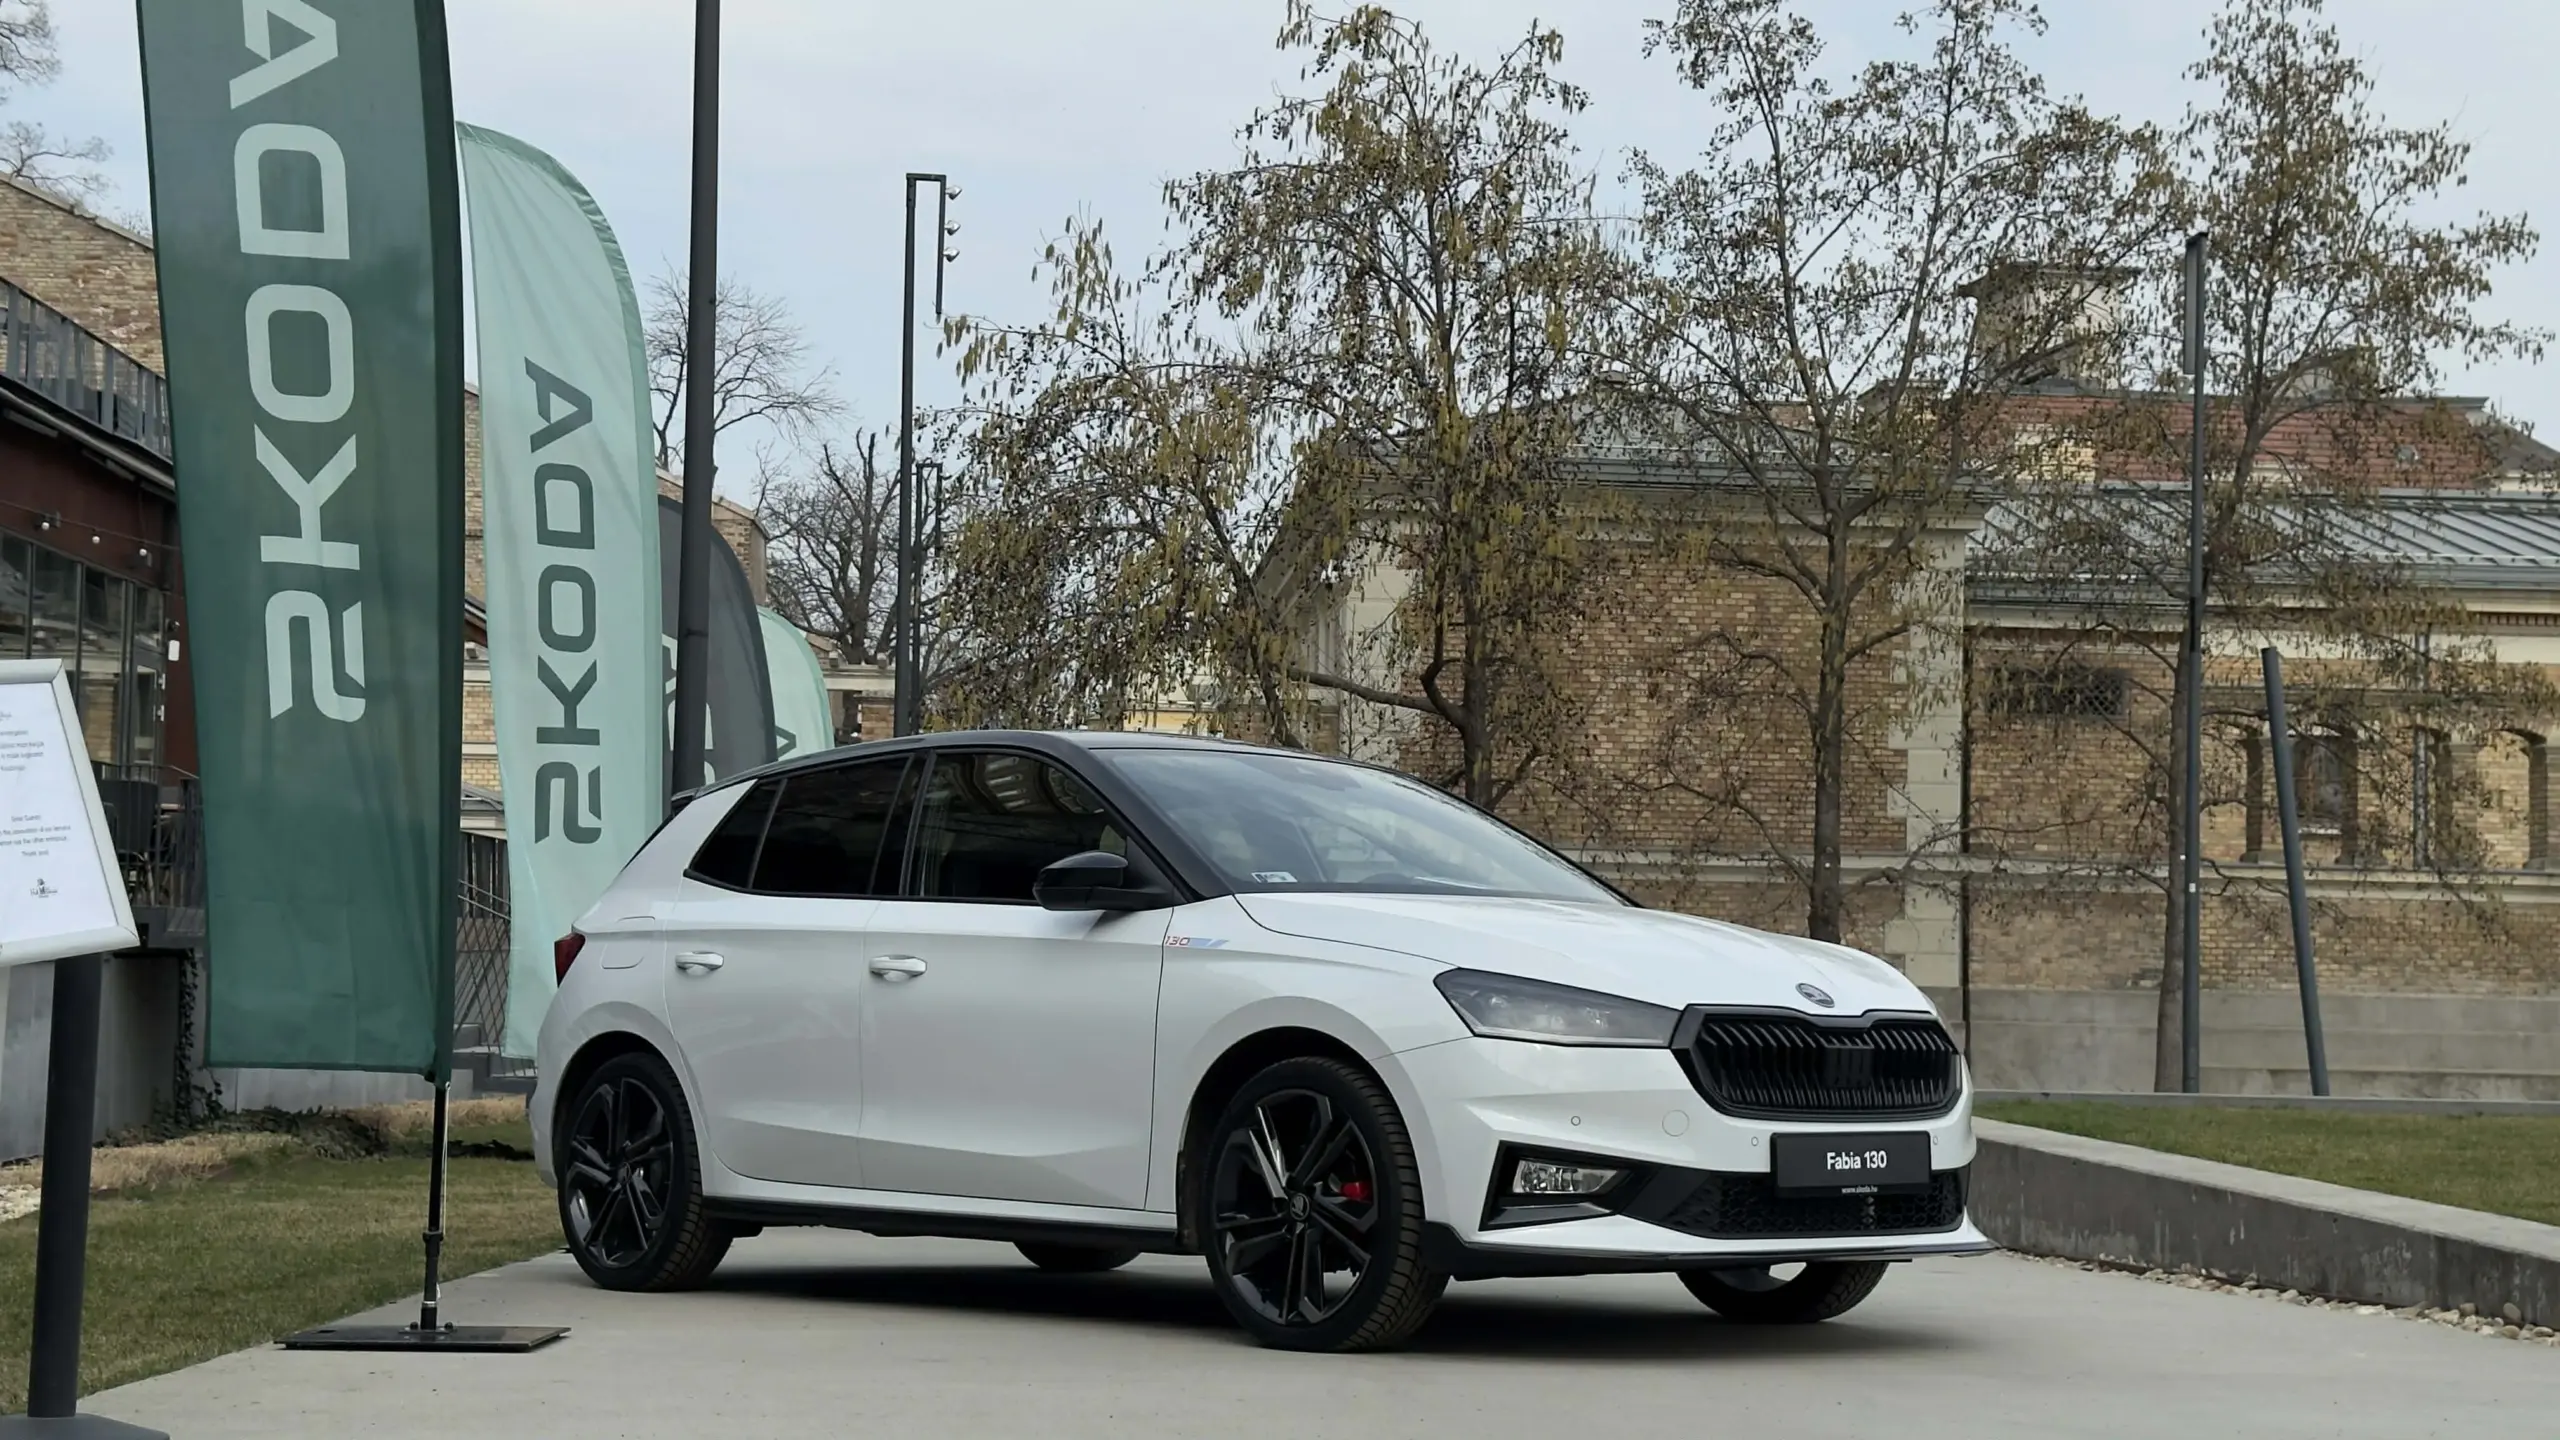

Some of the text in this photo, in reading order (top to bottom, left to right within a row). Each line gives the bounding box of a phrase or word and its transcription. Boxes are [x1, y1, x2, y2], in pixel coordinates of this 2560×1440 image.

[1165, 935, 1190, 946] 130
[1827, 1150, 1887, 1170] Fabia 130
